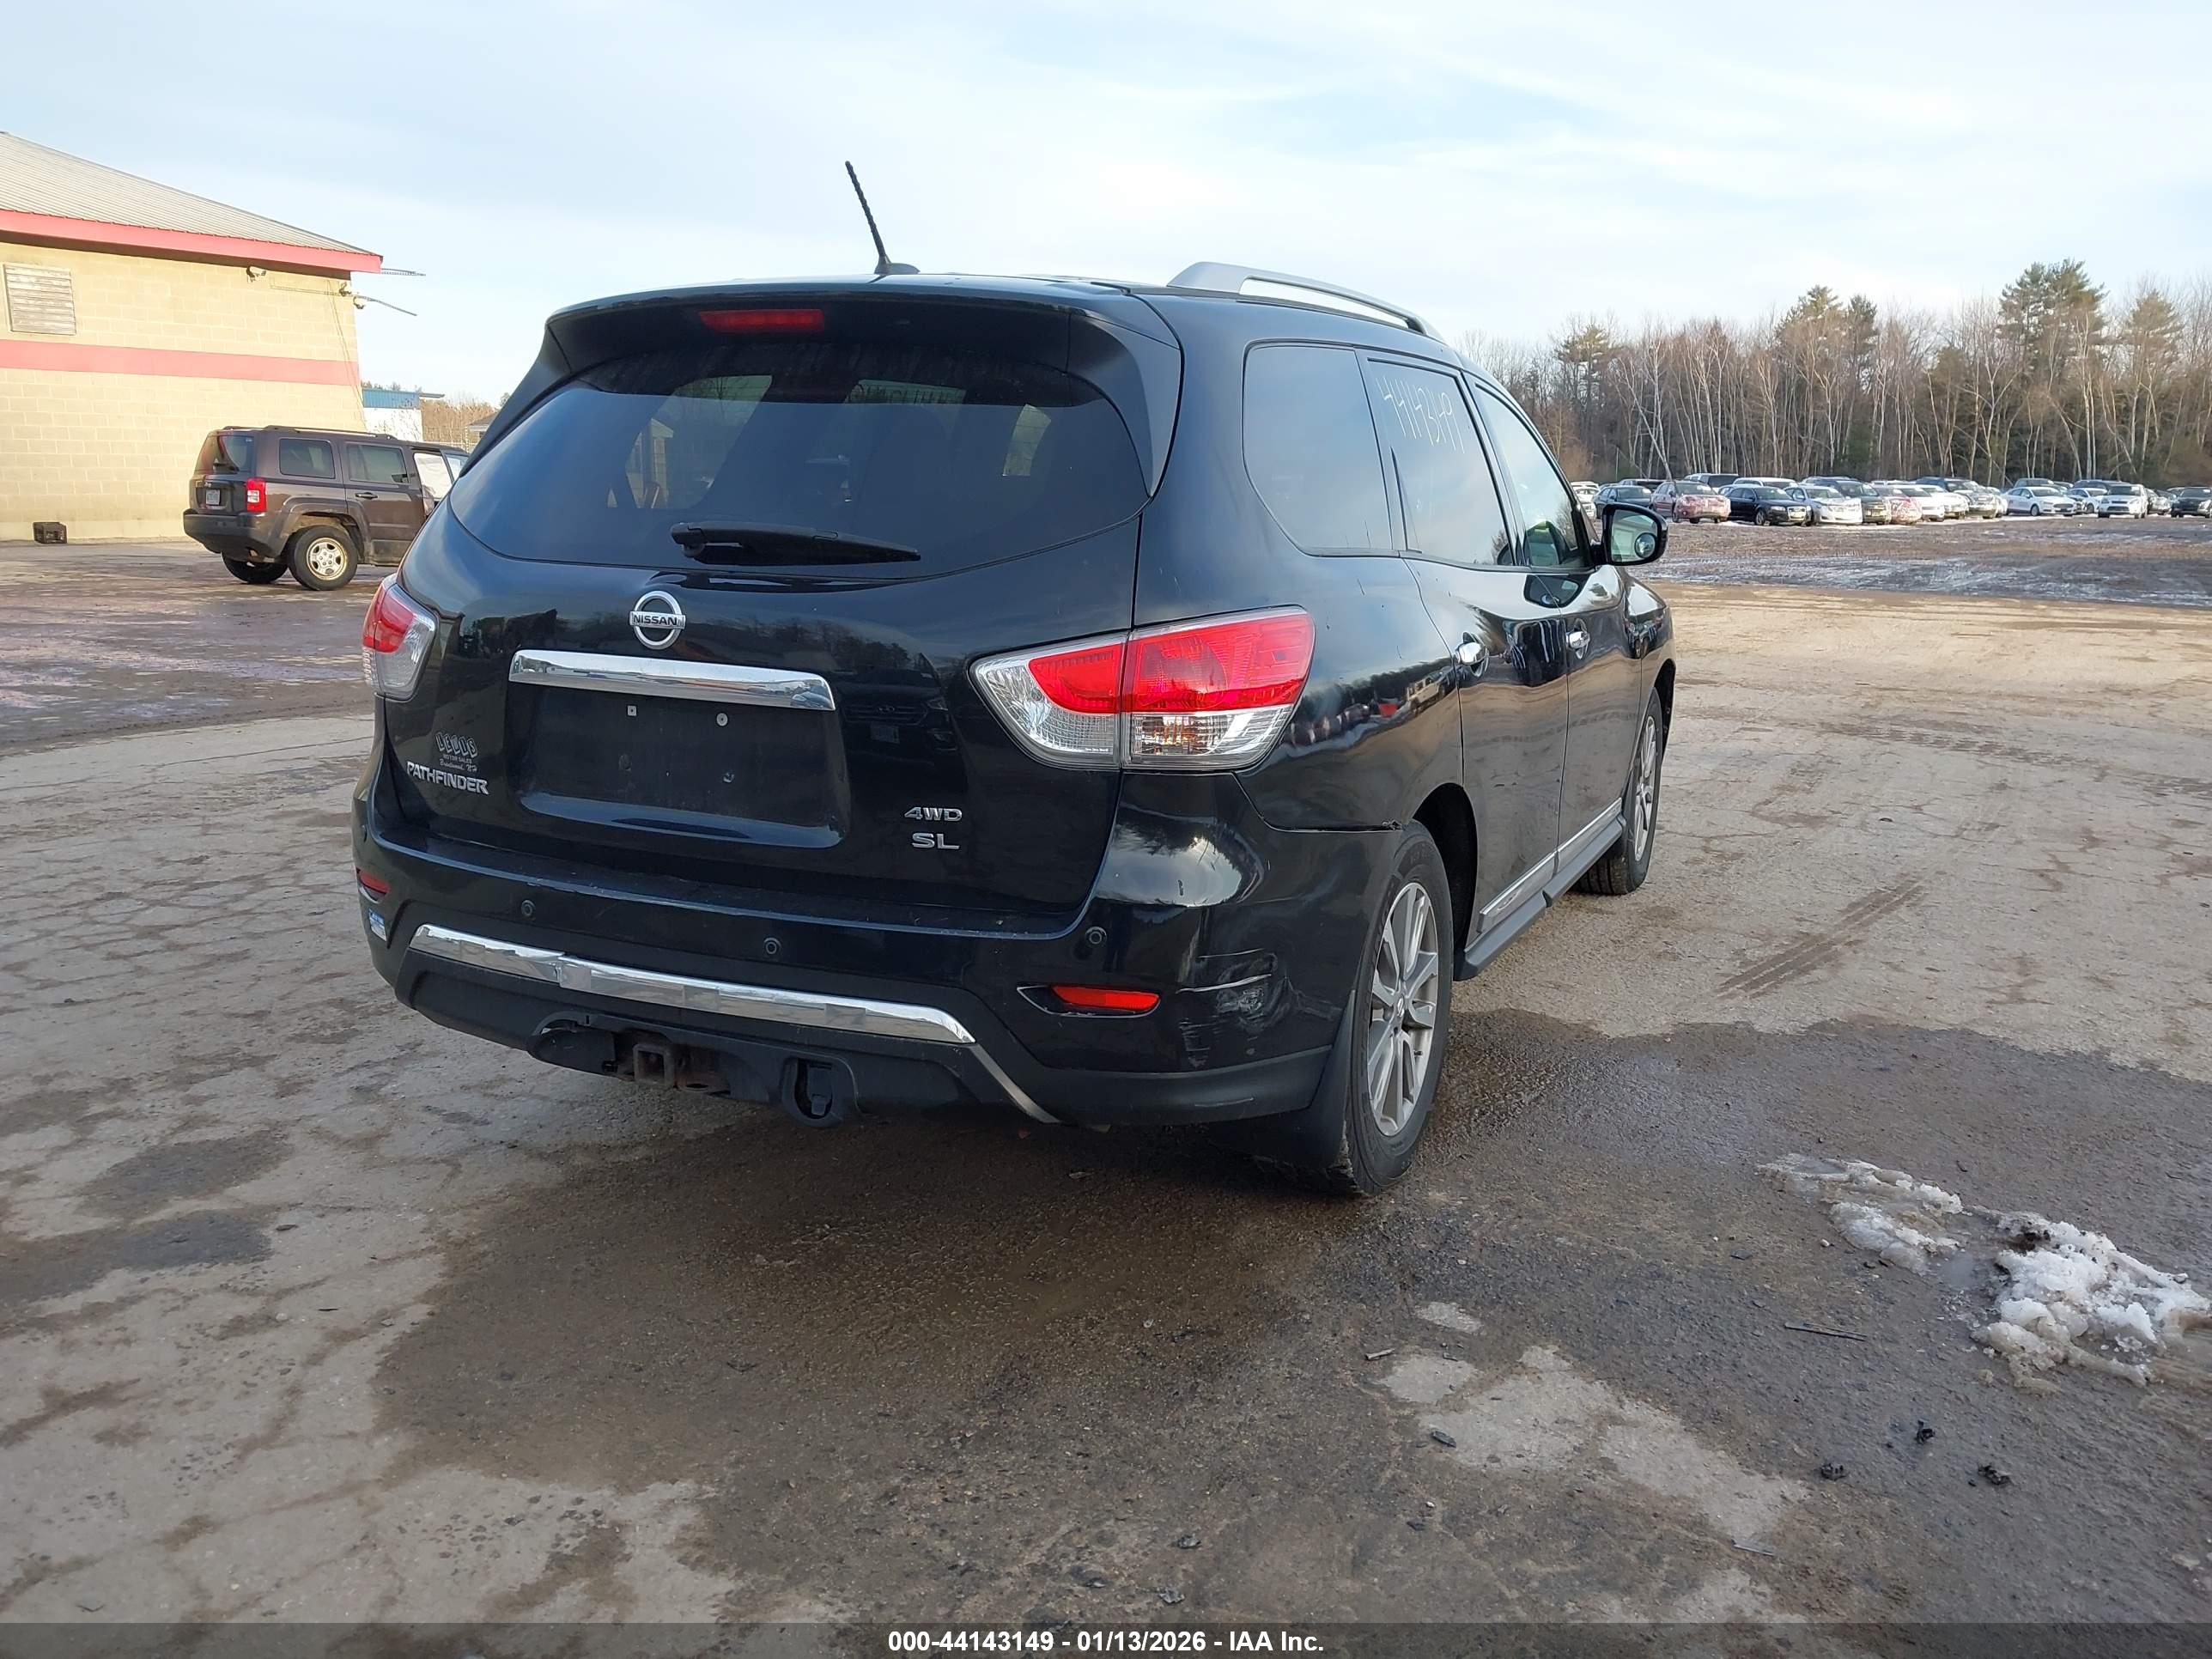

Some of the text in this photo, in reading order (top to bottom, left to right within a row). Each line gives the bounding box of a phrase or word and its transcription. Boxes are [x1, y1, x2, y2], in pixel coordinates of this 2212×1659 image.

[633, 614, 678, 626] NISSAN
[406, 761, 489, 795] PATHFINDER
[903, 806, 963, 822] 4WD
[911, 832, 960, 850] SL
